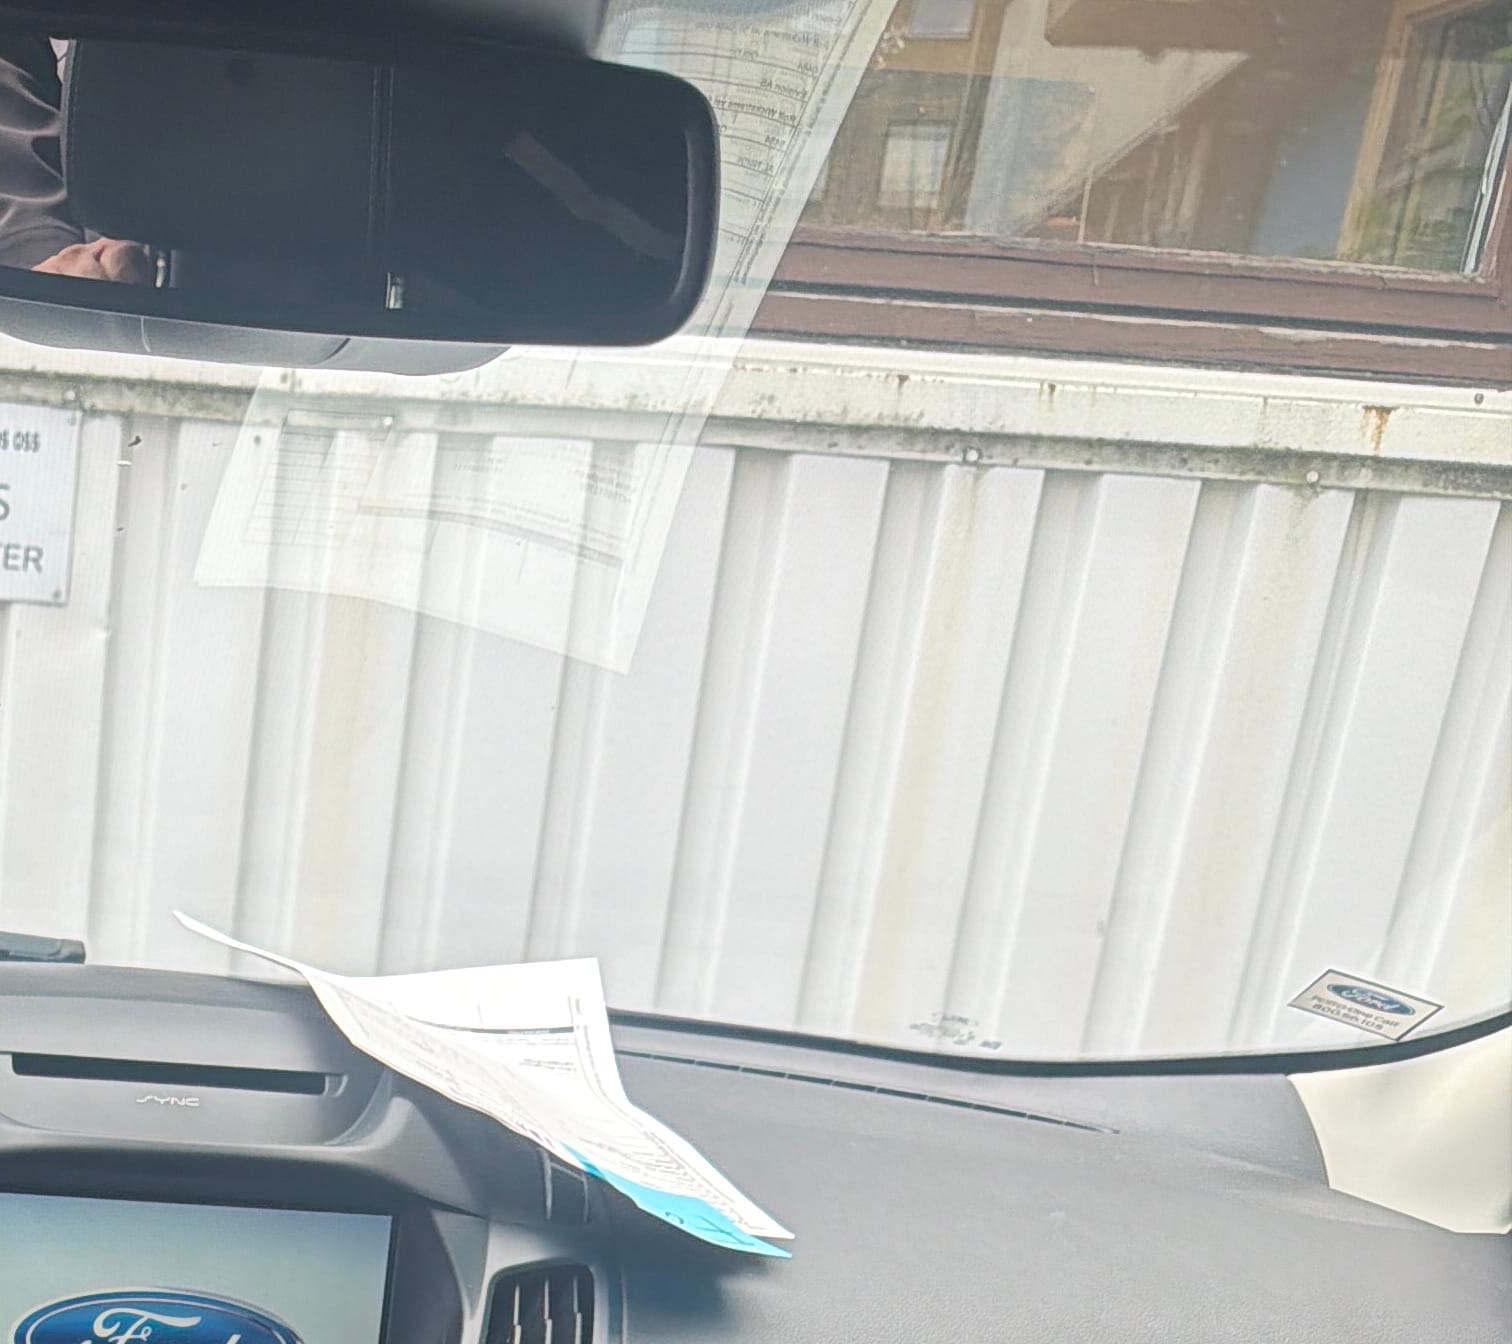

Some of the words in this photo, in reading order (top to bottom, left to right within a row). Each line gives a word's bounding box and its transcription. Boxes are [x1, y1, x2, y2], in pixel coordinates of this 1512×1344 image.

[13, 430, 40, 453] oss
[1341, 988, 1400, 1011] Ford
[136, 1095, 199, 1107] SYNC
